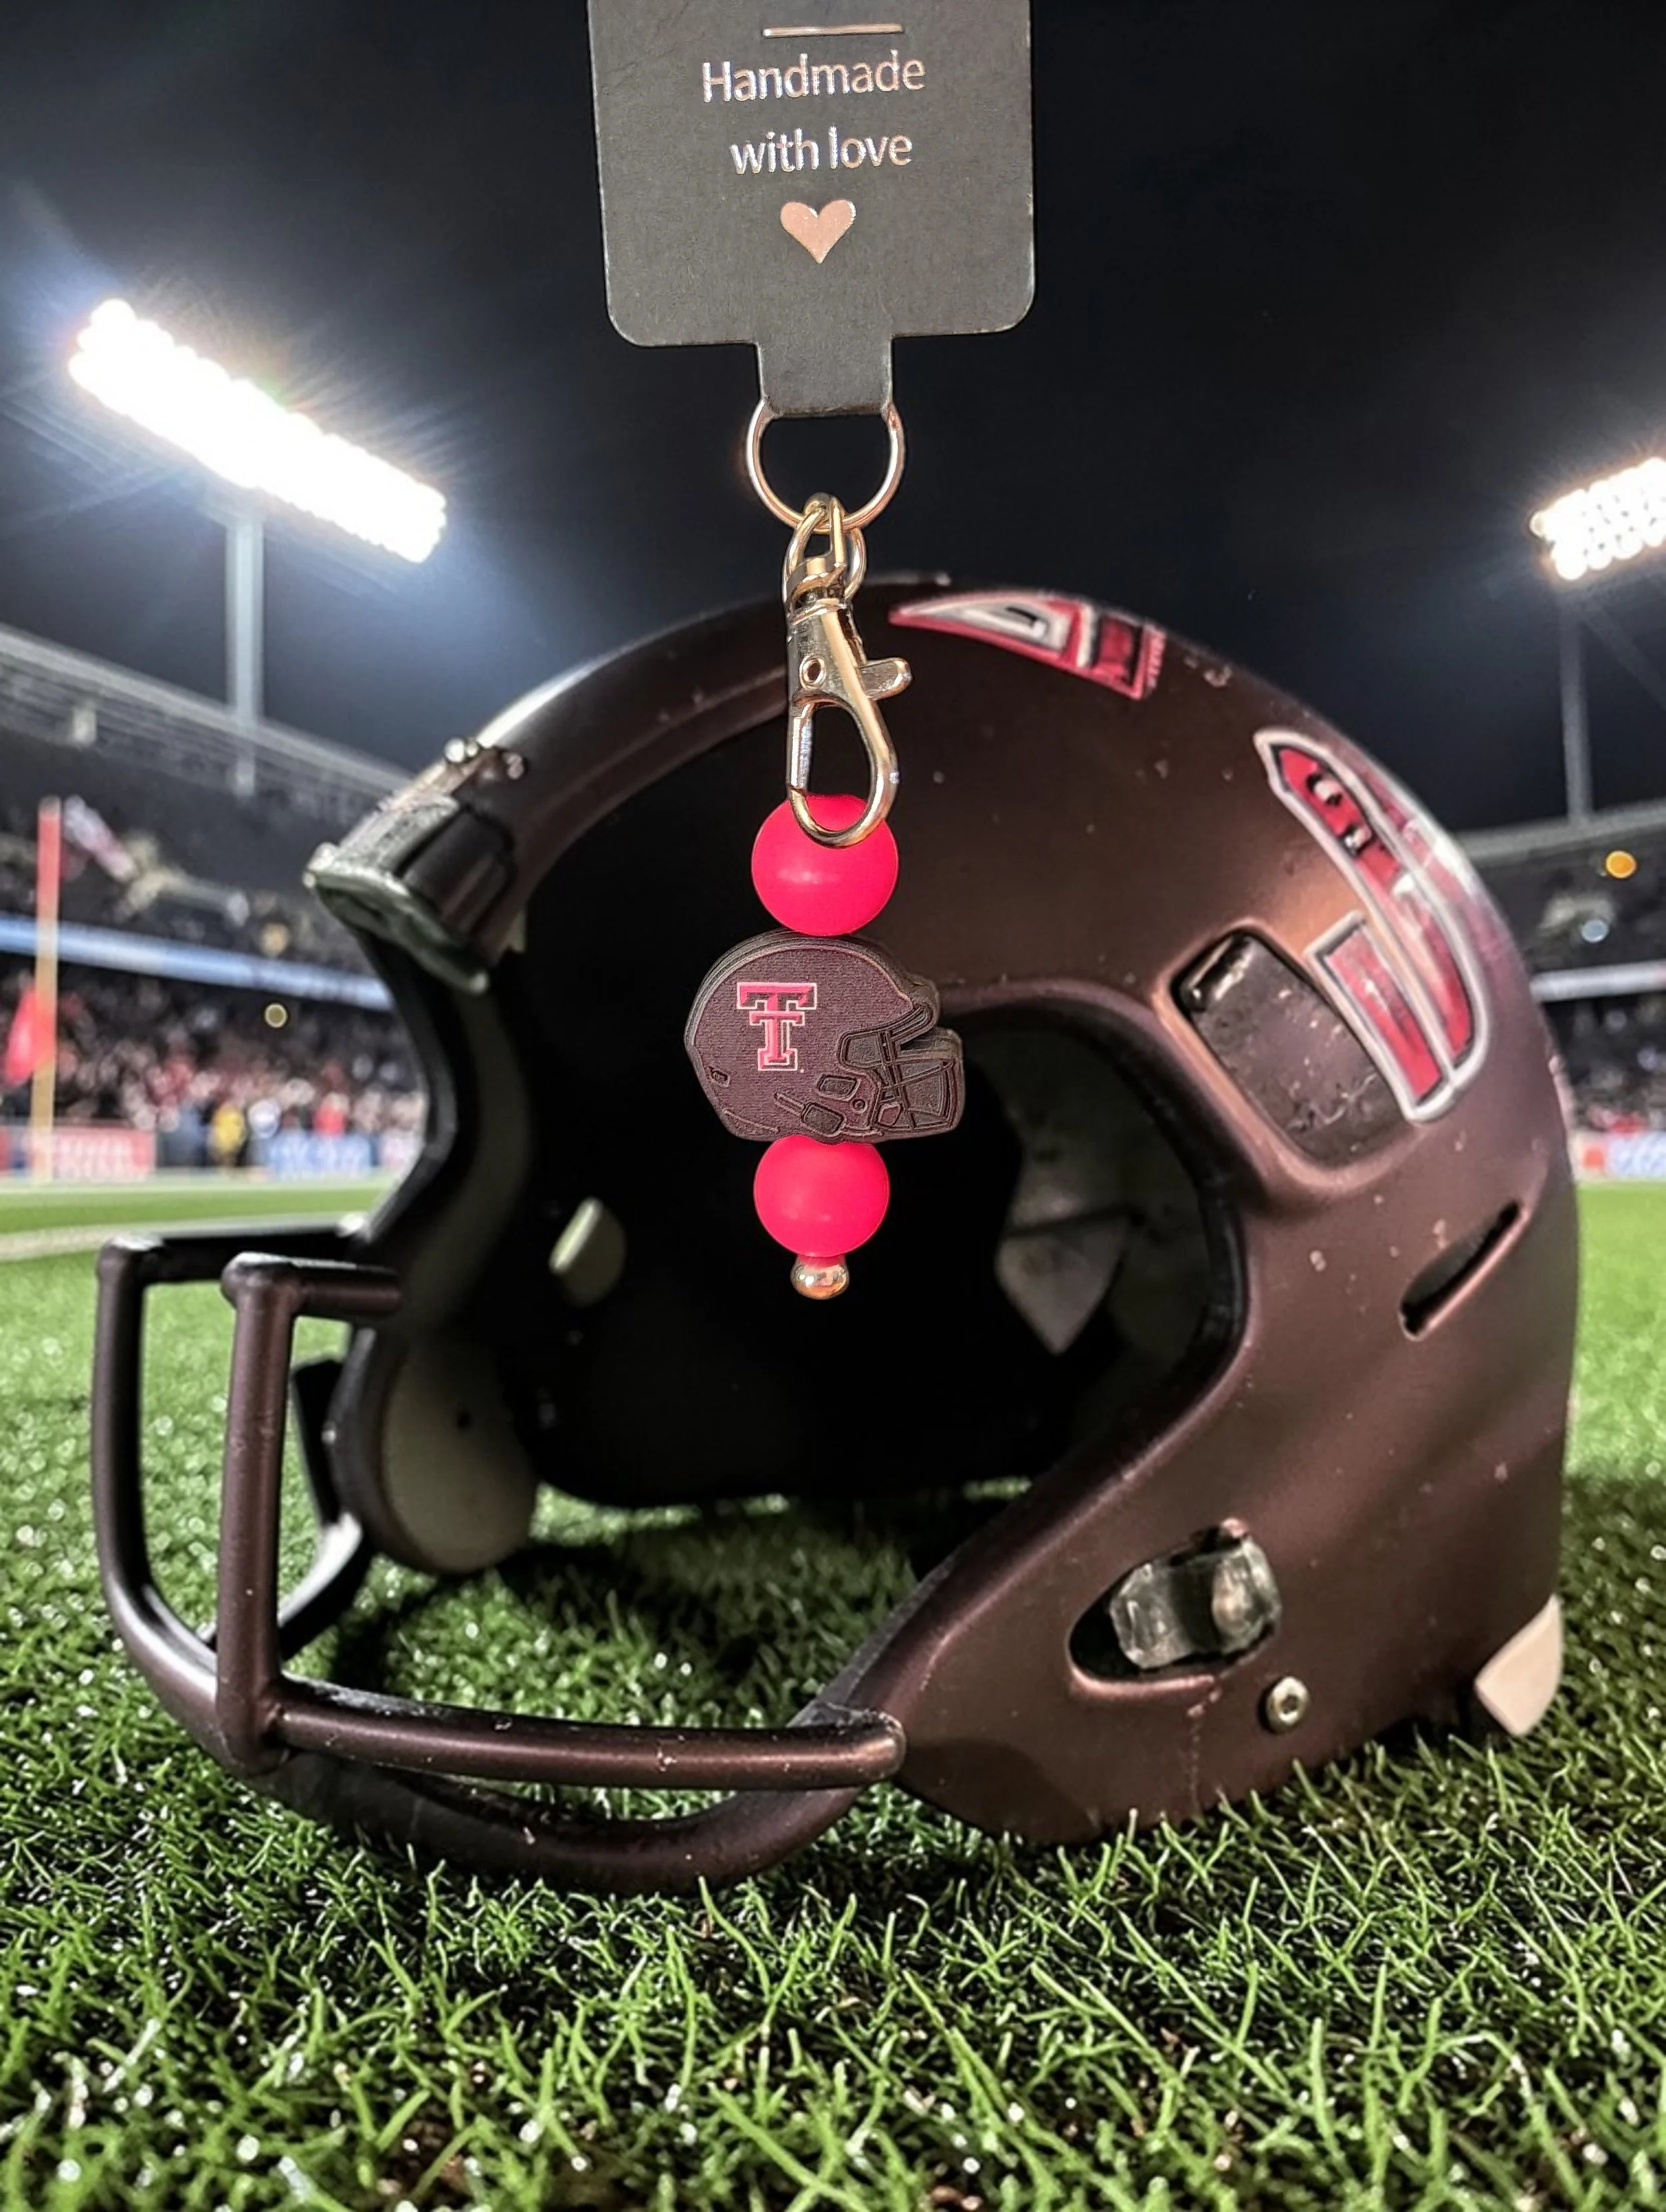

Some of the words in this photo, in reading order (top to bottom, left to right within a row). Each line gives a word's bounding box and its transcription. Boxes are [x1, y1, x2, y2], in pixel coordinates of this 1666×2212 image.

[702, 49, 926, 102] Handmade
[730, 127, 819, 174] with
[828, 126, 912, 169] love
